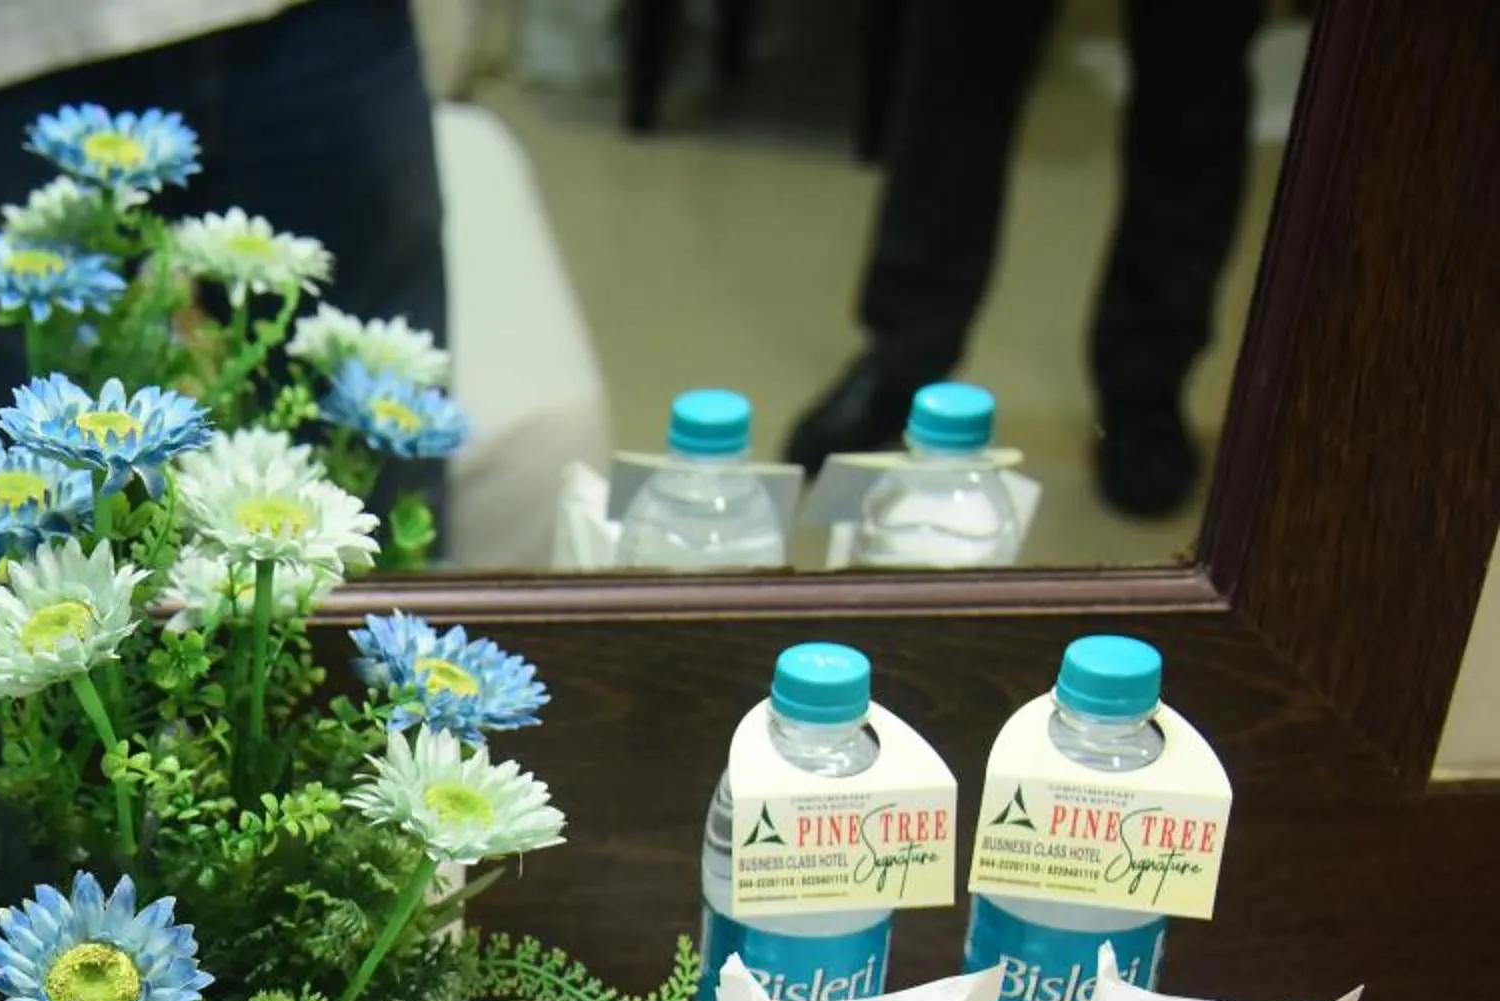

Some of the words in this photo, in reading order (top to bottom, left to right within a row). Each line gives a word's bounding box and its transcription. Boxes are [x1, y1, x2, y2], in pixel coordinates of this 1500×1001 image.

[796, 814, 861, 848] PINE
[879, 808, 948, 843] TREE
[982, 836, 1031, 856] BUSINESS
[1033, 843, 1067, 859] CLASS
[1069, 847, 1101, 864] HOTEL
[1049, 804, 1121, 842] PINE
[1141, 814, 1217, 853] TREE
[739, 855, 784, 872] BUSINESS
[786, 853, 817, 870] CLASS
[819, 852, 849, 869] HOTEL
[854, 802, 939, 900] Signature
[1104, 806, 1203, 906] Signature
